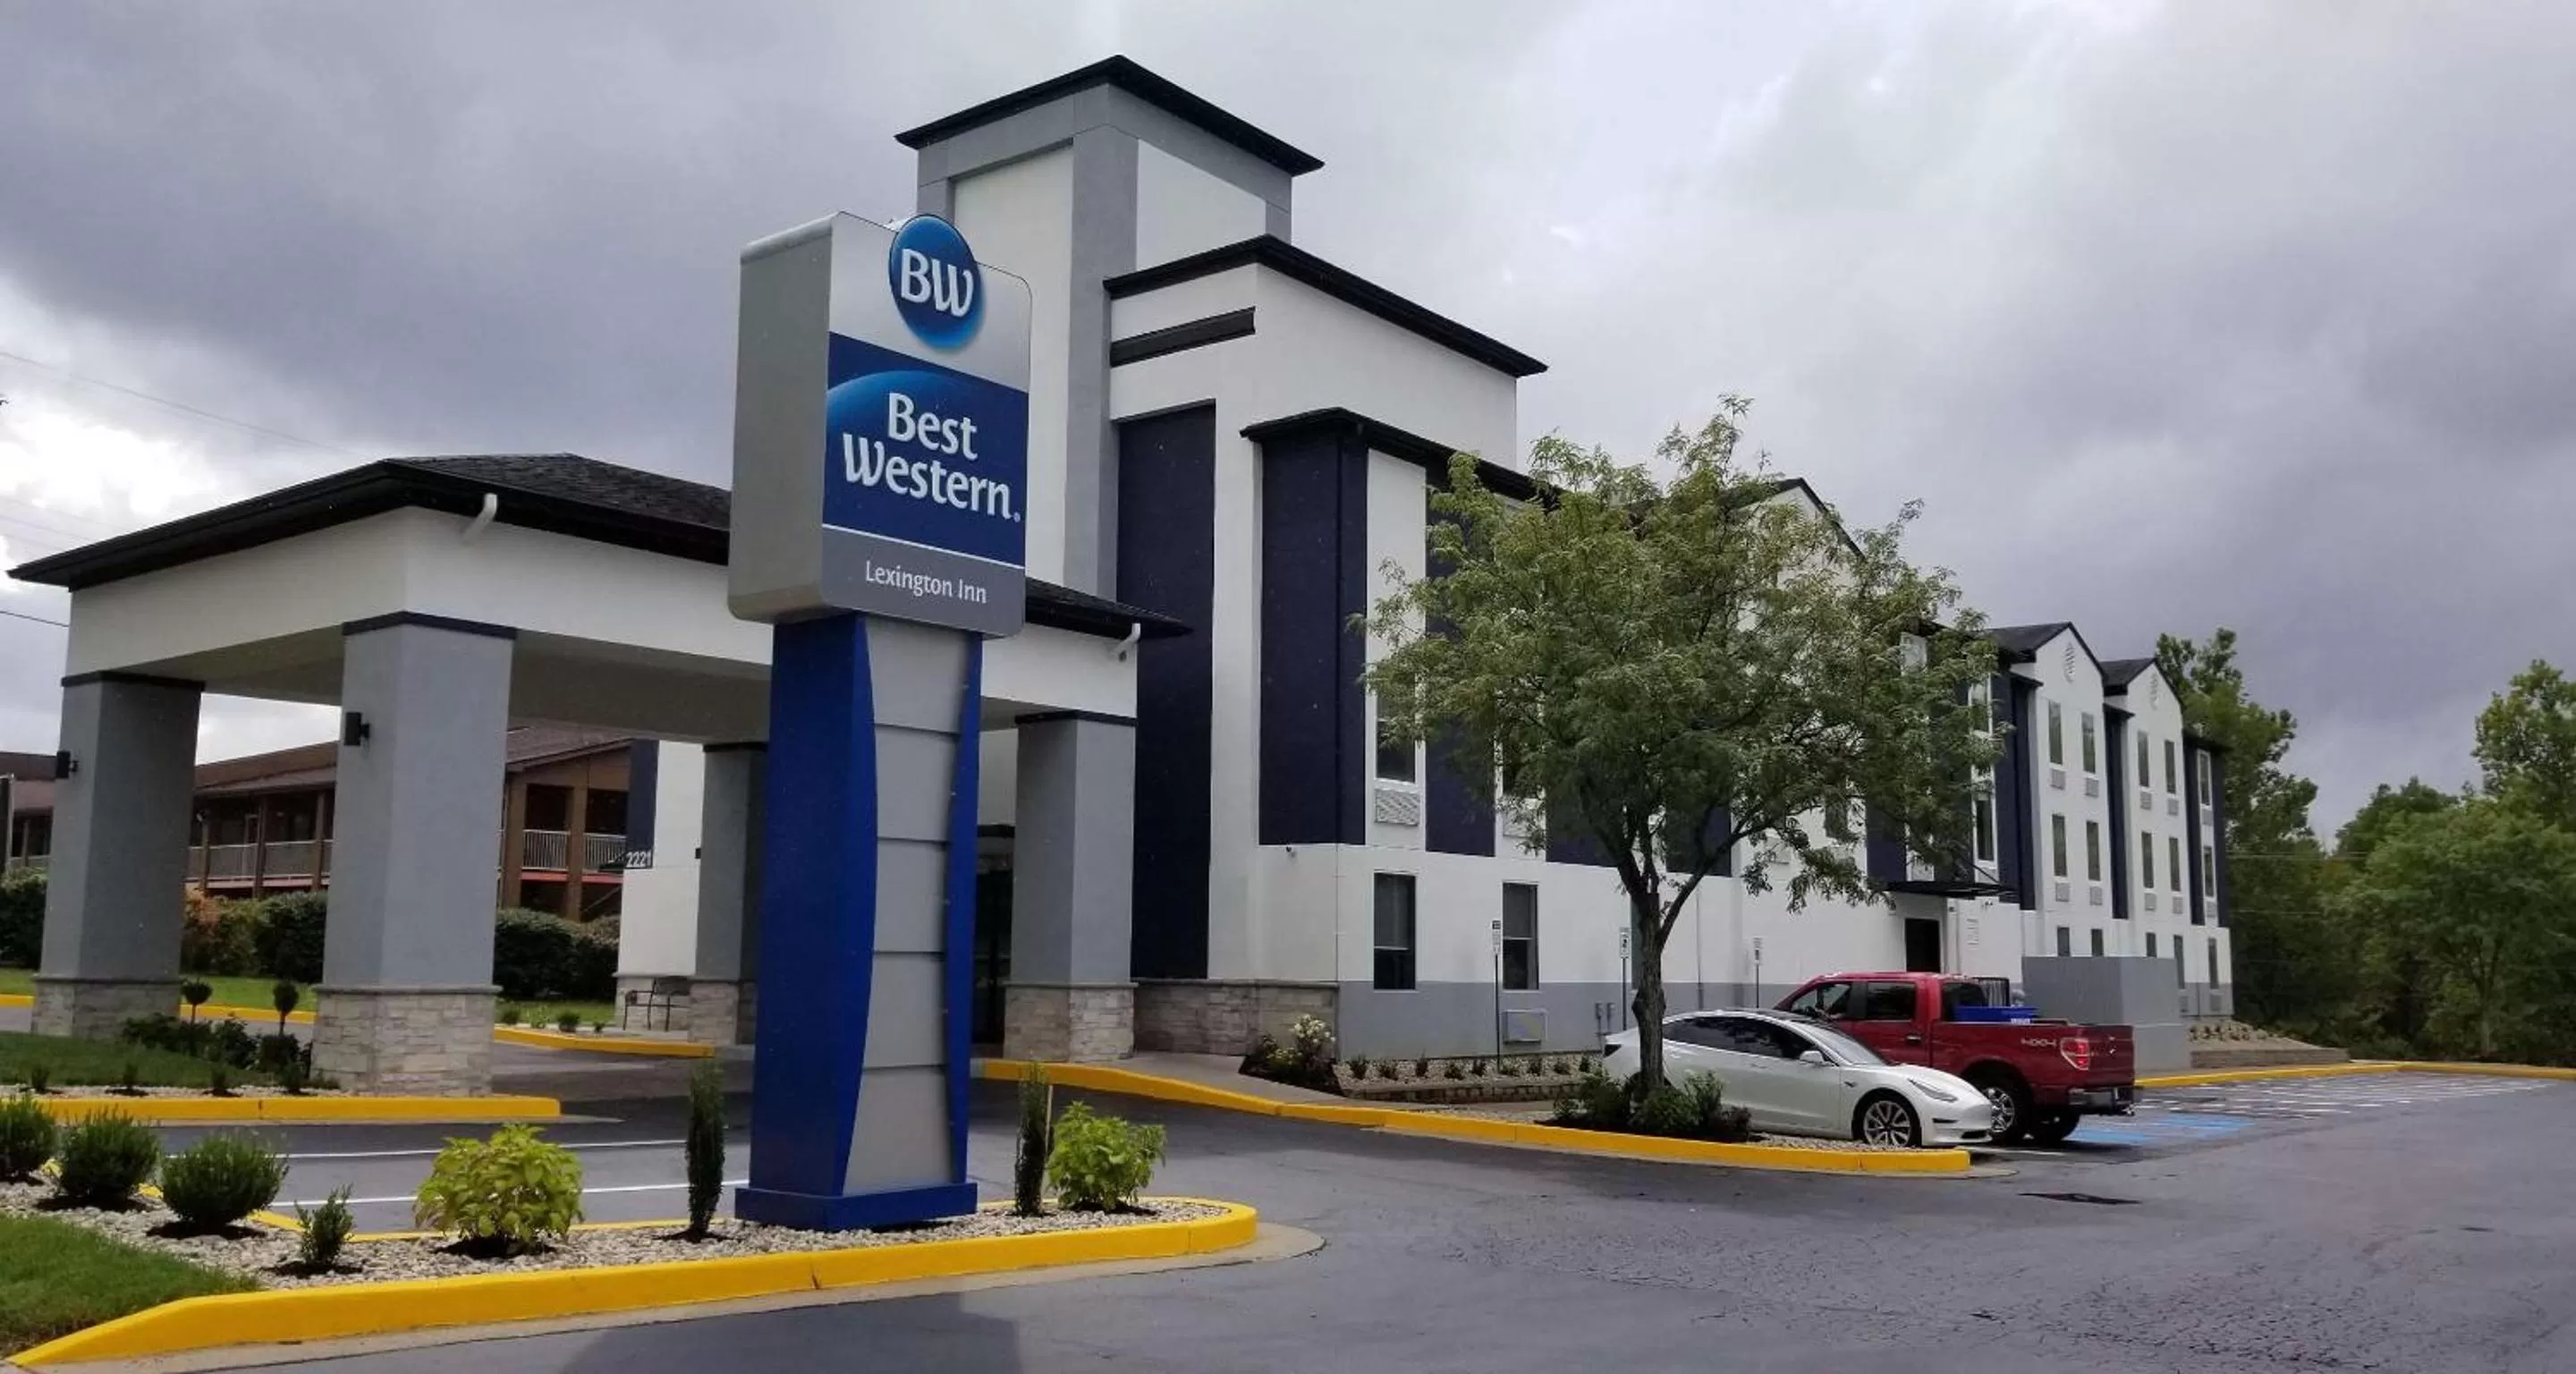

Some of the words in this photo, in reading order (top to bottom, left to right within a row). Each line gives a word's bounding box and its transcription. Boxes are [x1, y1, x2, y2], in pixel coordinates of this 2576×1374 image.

[901, 248, 974, 317] BW
[888, 392, 978, 461] Best
[866, 560, 953, 598] Lexington
[958, 579, 987, 604] Inn
[626, 850, 652, 868] 2221
